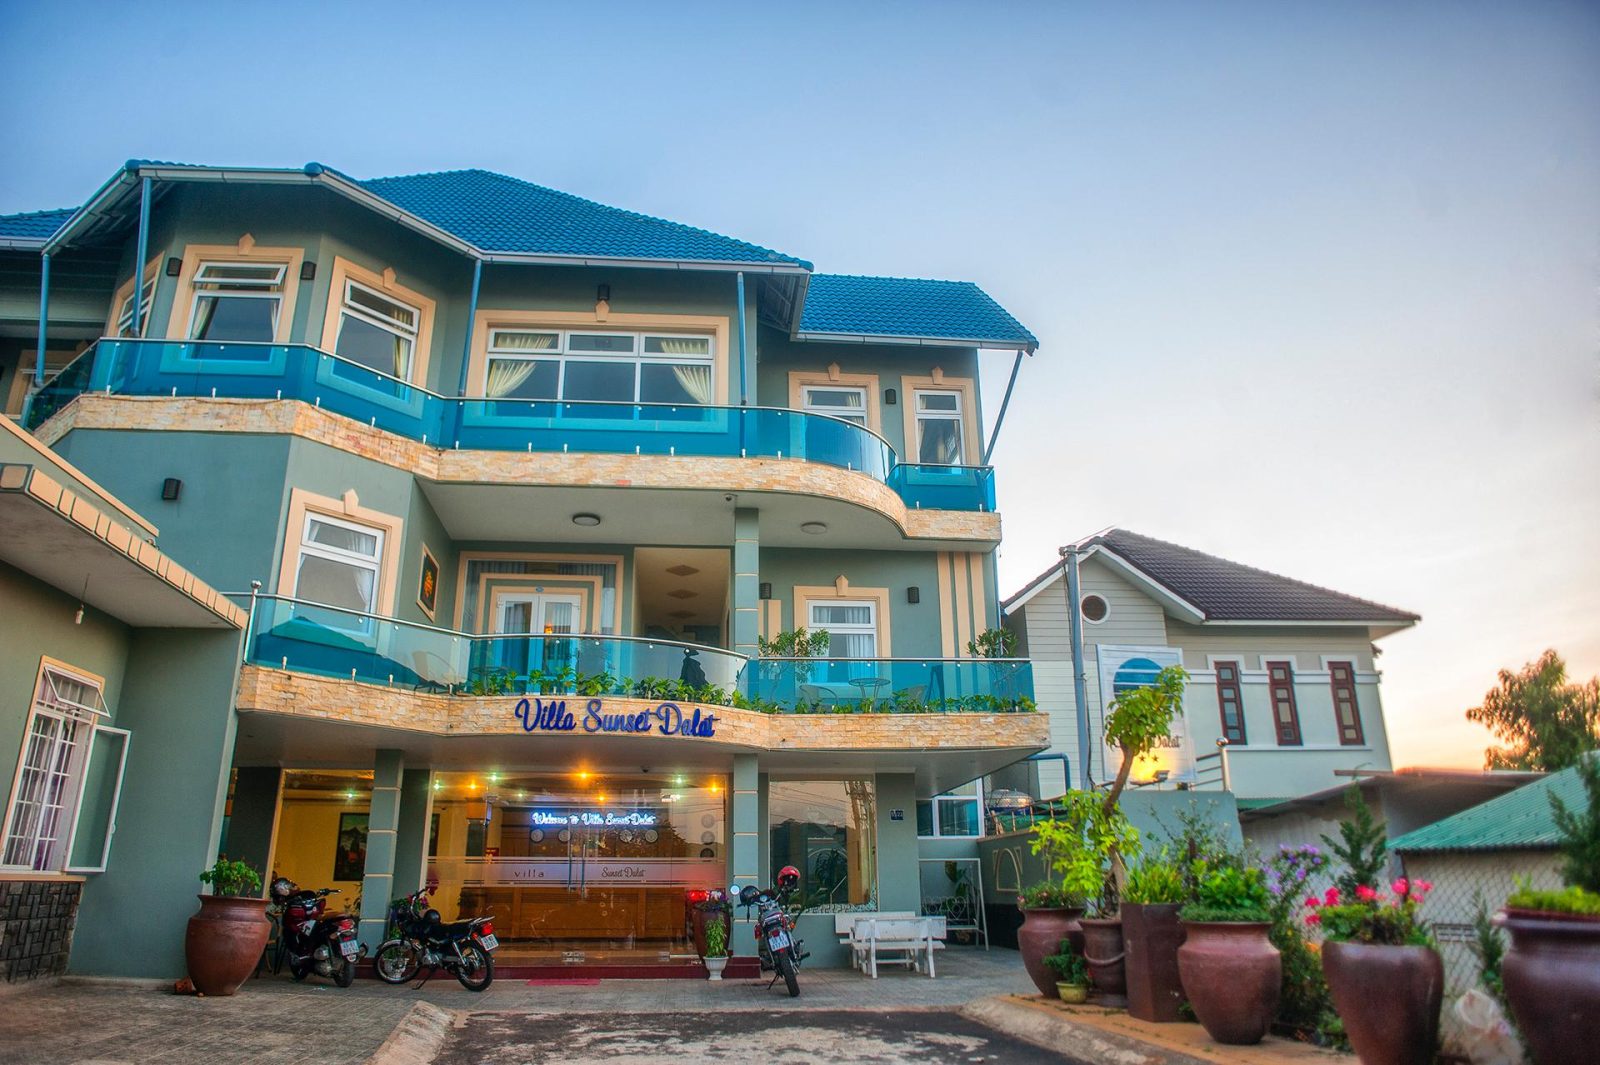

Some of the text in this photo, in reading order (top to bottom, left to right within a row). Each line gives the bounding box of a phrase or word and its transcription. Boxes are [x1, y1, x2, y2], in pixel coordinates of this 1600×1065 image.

[514, 698, 721, 738] Villa Sunset Dalat
[581, 812, 604, 826] Villa
[605, 812, 631, 826] Sunset
[513, 866, 647, 878] villa Sunset Dalat
